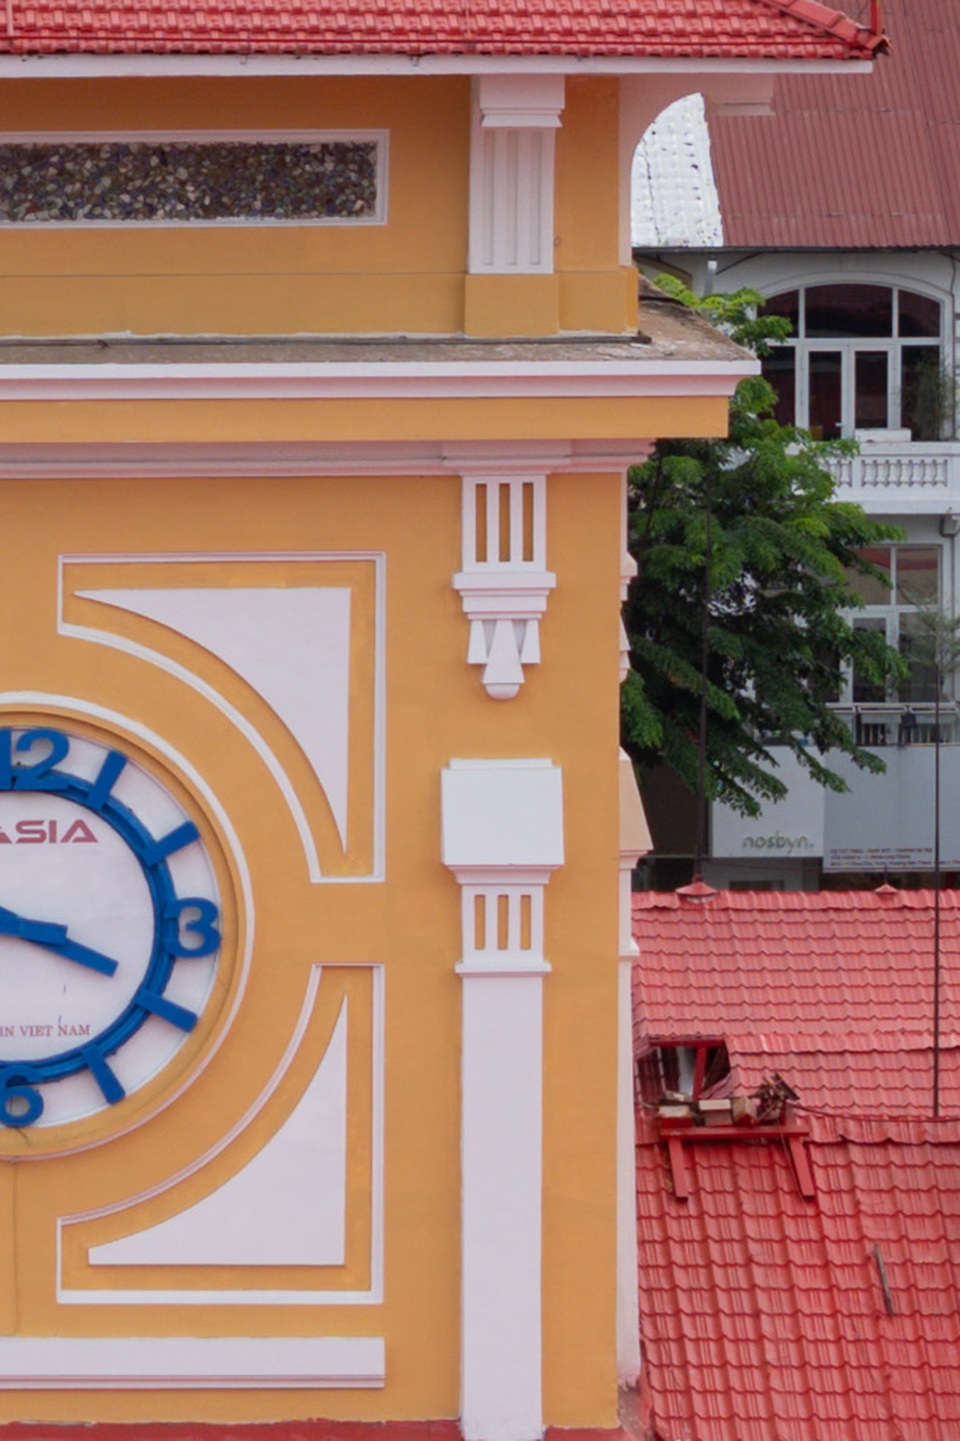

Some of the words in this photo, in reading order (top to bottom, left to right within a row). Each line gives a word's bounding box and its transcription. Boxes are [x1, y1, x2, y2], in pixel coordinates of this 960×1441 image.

[164, 897, 221, 958] 3
[20, 1024, 53, 1037] VIET
[58, 1023, 91, 1036] NAM
